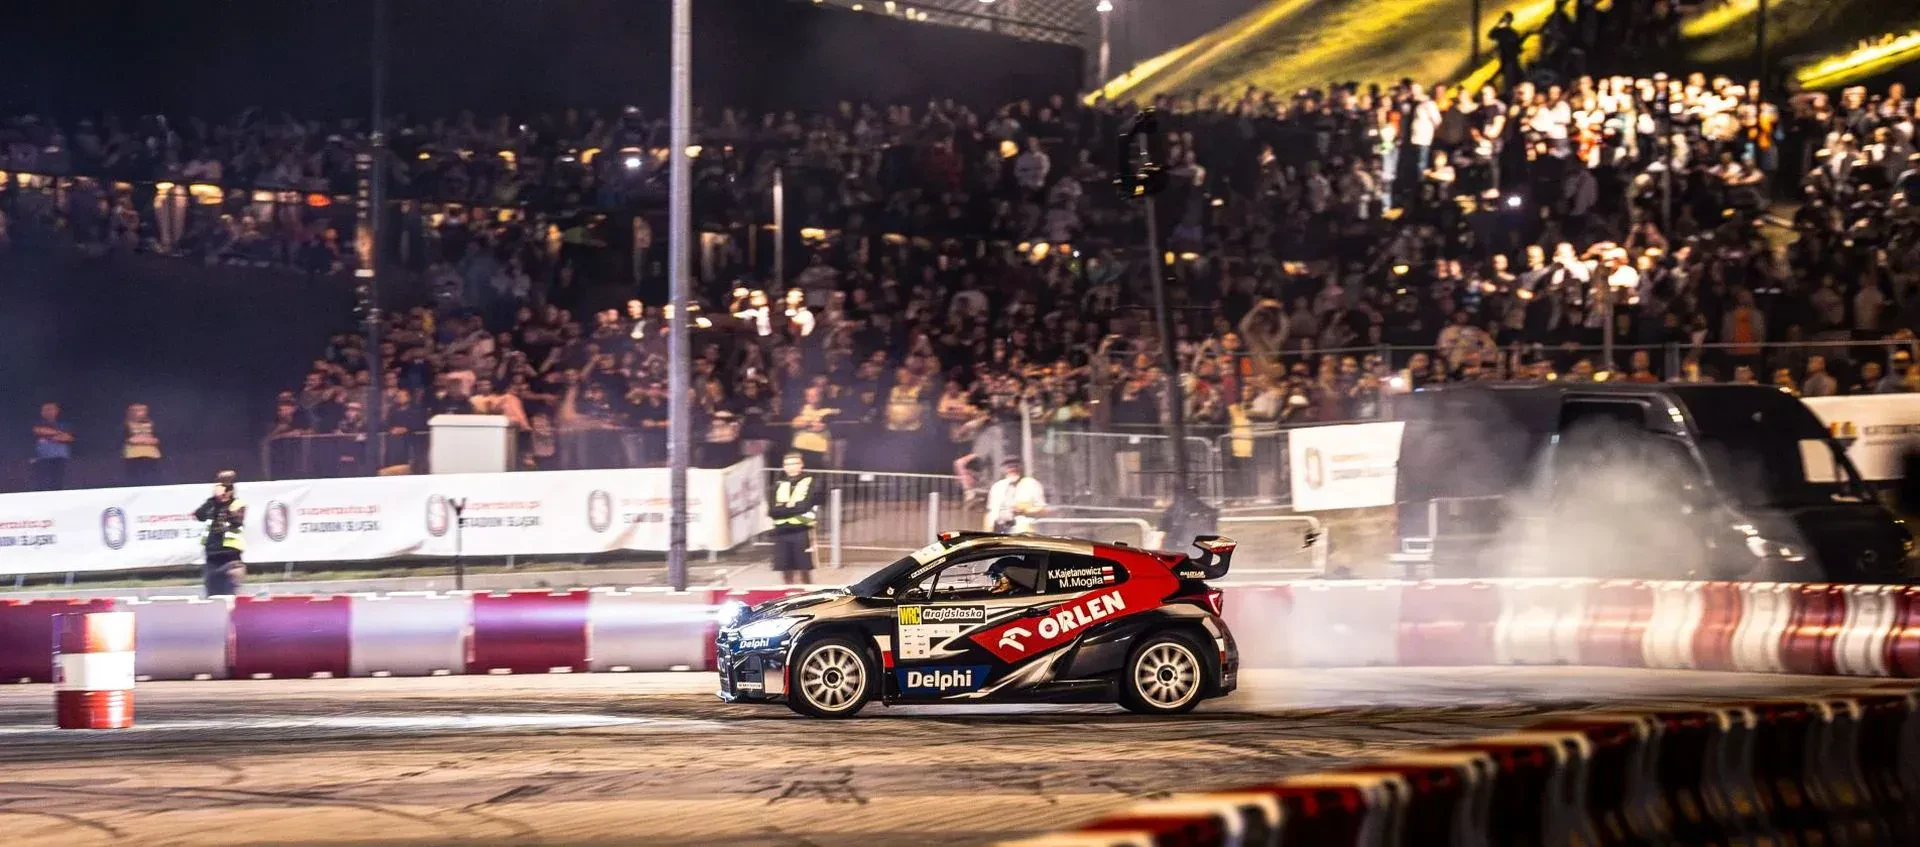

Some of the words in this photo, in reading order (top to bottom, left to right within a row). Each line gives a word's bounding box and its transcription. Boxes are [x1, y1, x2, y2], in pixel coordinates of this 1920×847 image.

[900, 606, 920, 625] WRC
[923, 608, 983, 621] #rajdslaska
[1038, 590, 1126, 639] ORLEN
[740, 638, 769, 649] Delphi
[907, 670, 971, 691] Delphi
